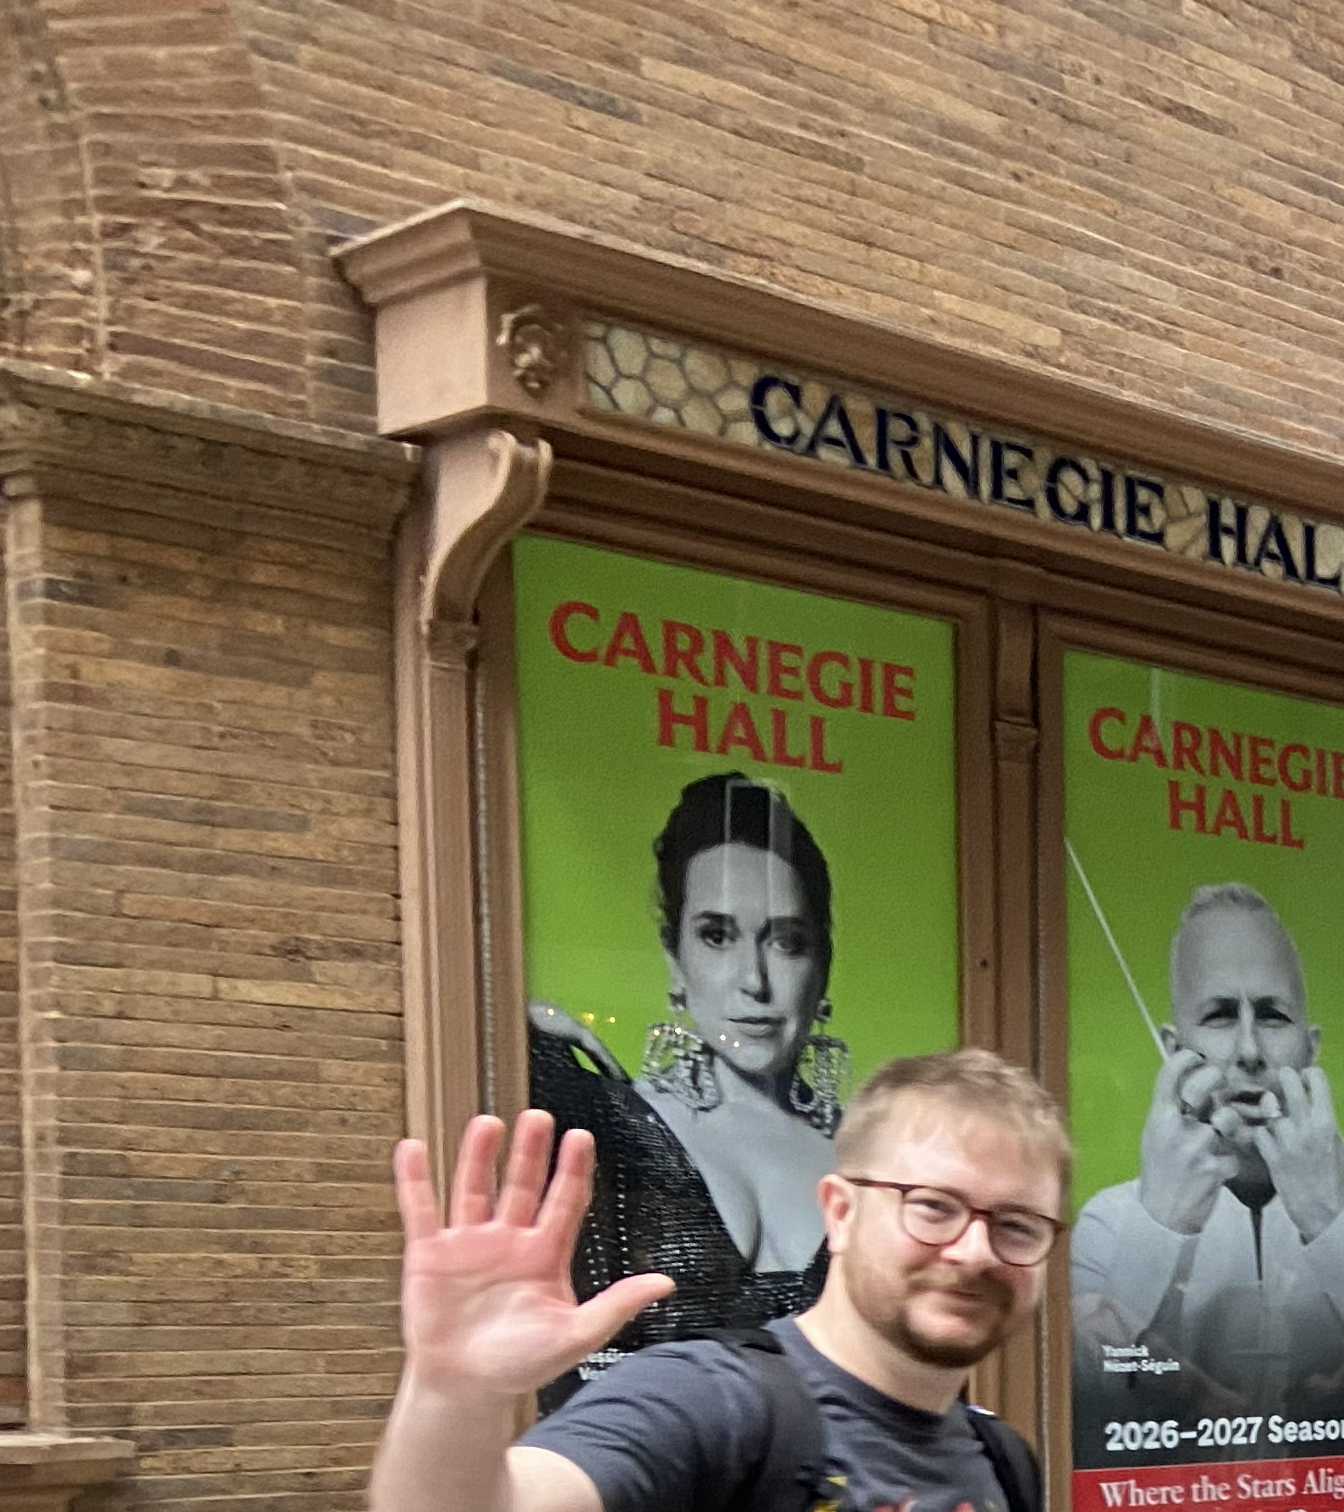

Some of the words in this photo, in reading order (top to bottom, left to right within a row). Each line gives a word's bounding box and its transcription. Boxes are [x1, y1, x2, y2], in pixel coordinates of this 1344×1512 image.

[750, 375, 1164, 544] CARNEGIE
[549, 600, 916, 722] CARNEGIE
[657, 687, 844, 774] HALL
[1167, 779, 1305, 850] HALL
[1100, 1479, 1185, 1508] Where
[1190, 1475, 1232, 1504] the
[1236, 1472, 1297, 1500] Stars
